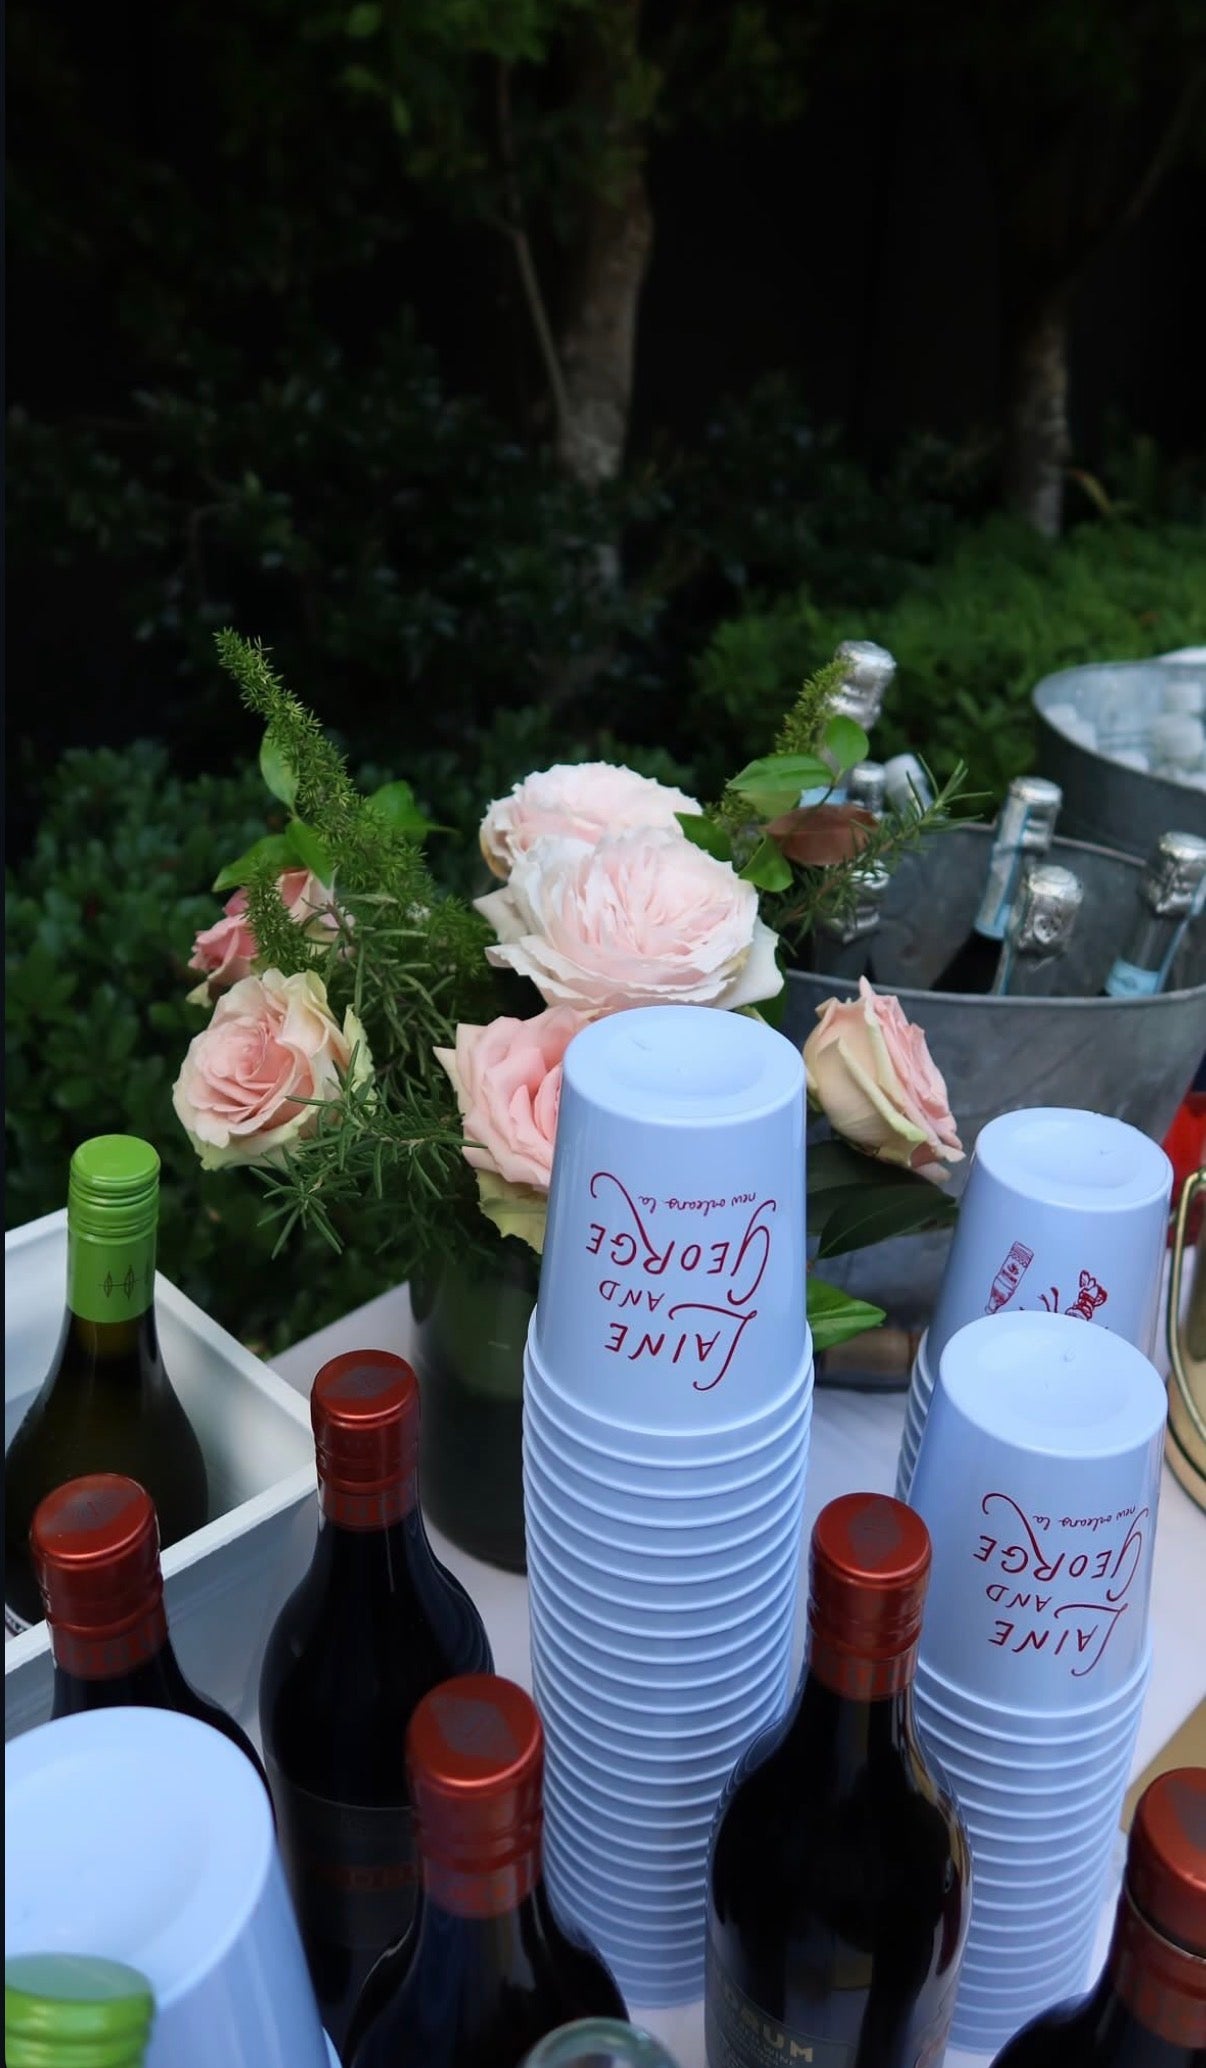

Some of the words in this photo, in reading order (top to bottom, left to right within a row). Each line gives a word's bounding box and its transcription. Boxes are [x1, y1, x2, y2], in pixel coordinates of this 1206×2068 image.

[731, 1192, 756, 1206] new
[586, 1172, 776, 1306] GEORGE
[599, 1280, 665, 1312] AND
[604, 1303, 757, 1391] LAINE
[1116, 1504, 1136, 1521] new
[973, 1493, 1149, 1602] GEORGE
[986, 1584, 1052, 1612] AND
[988, 1603, 1129, 1676] LAINE
